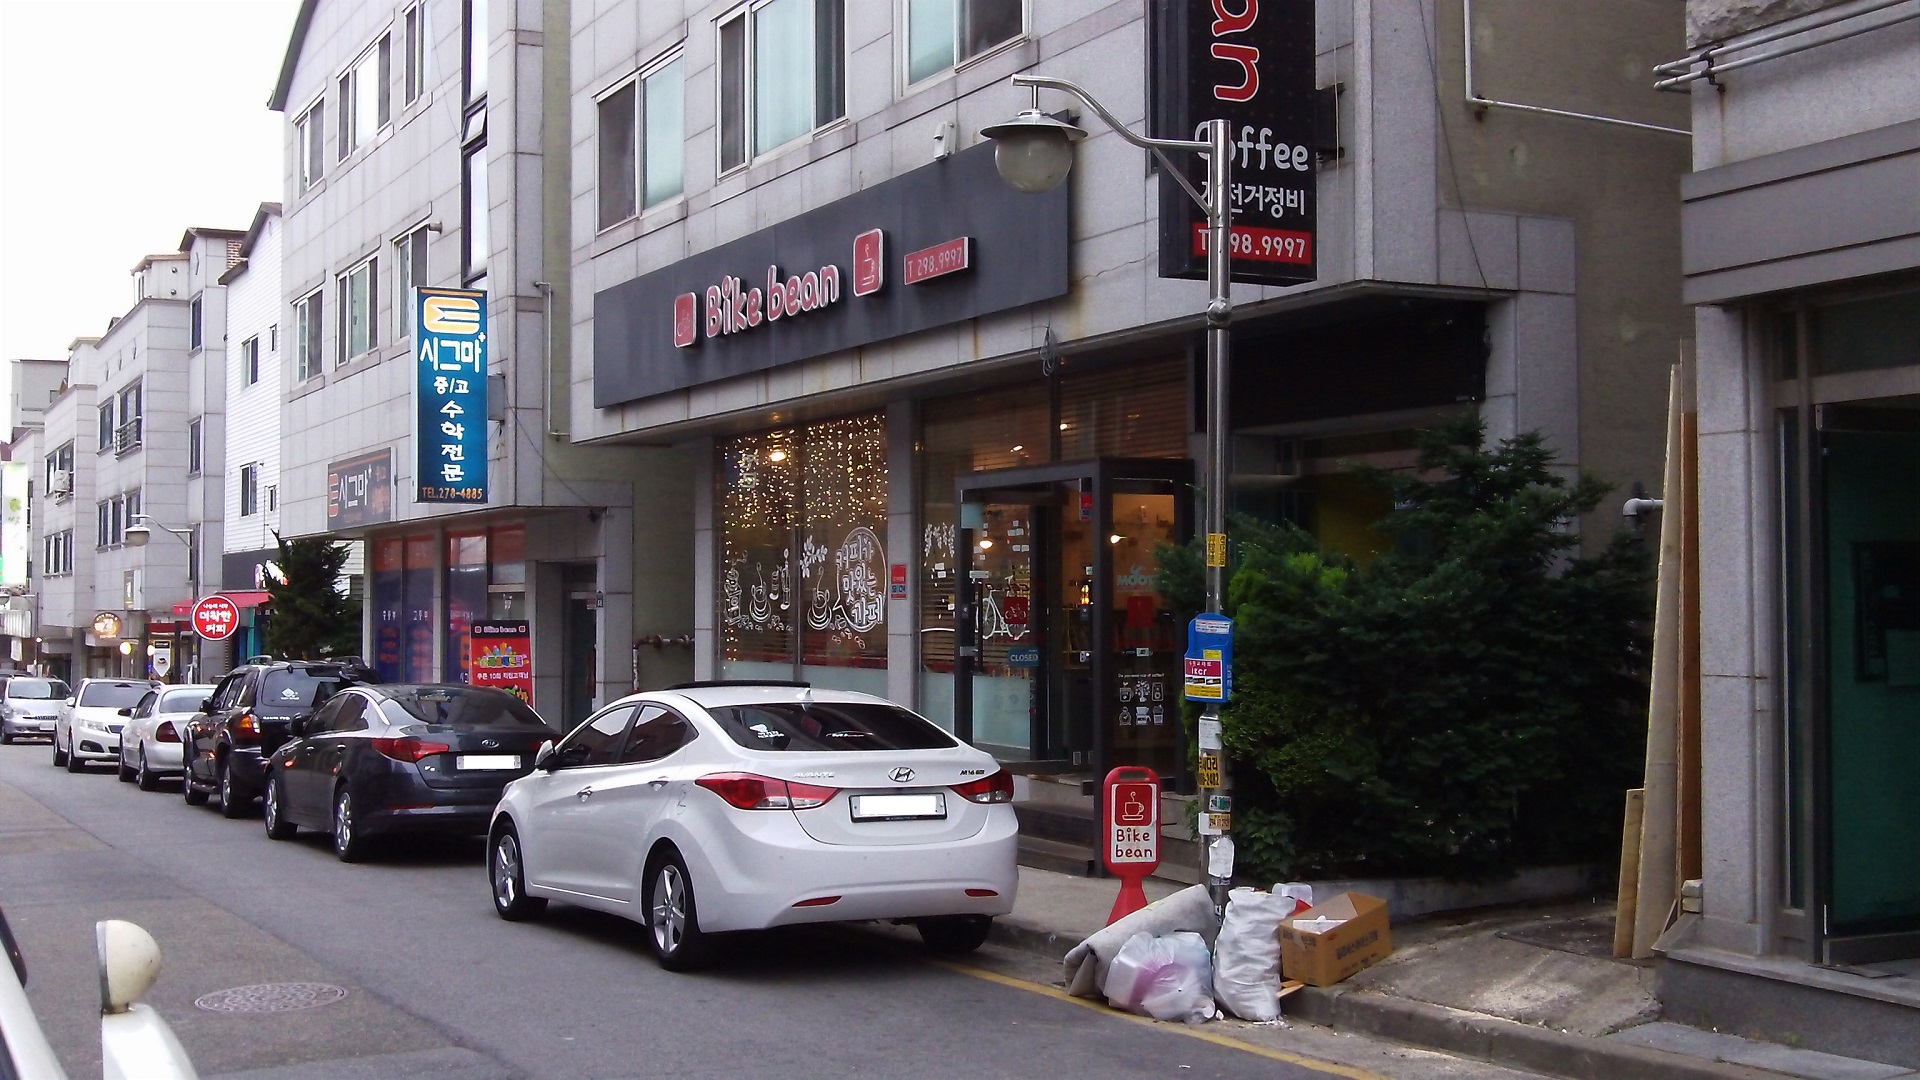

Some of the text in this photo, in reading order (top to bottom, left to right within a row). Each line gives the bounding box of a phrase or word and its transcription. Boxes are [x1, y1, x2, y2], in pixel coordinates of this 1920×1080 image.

[907, 246, 962, 278] T 298.9997
[706, 264, 840, 339] Bike bean
[433, 375, 470, 395] 중/고
[842, 561, 877, 605] 맛있는
[851, 591, 883, 625] 카페
[205, 623, 227, 635] 커피
[1010, 653, 1039, 662] CLOSED
[793, 771, 835, 779] AVANTE
[1116, 827, 1150, 842] Bike
[1115, 844, 1153, 858] bean
